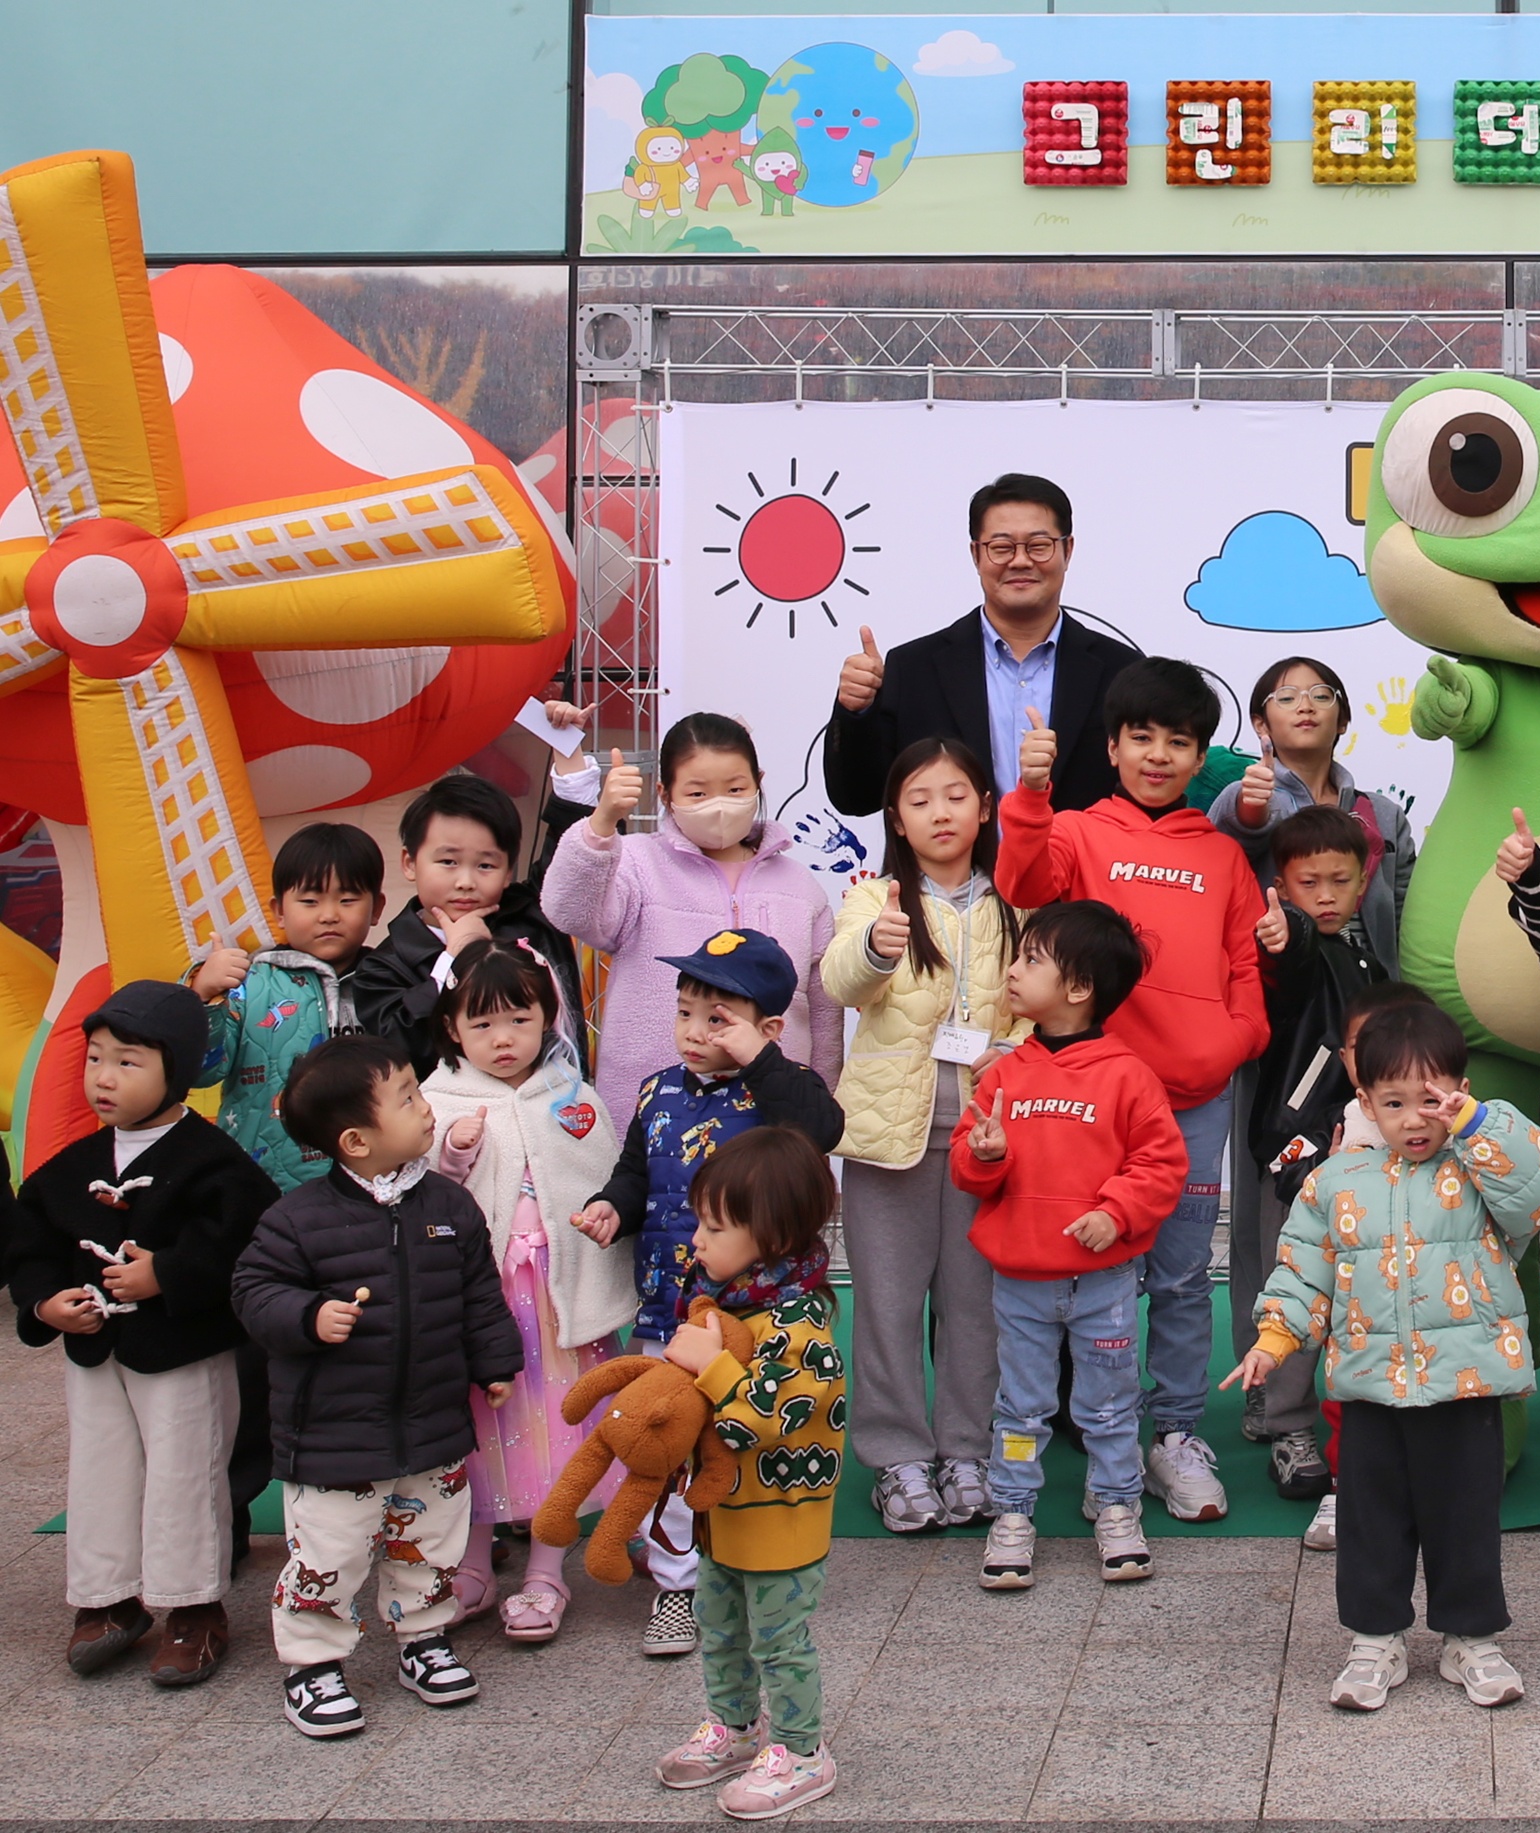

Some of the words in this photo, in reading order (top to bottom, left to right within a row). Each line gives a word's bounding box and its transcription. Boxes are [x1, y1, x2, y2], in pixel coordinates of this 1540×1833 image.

[1109, 861, 1206, 894] MARVEL
[1009, 1098, 1097, 1123] MARVEL
[1188, 1185, 1208, 1194] TURN
[1095, 1340, 1113, 1348] TURN
[1114, 1340, 1121, 1348] IT
[1453, 1650, 1466, 1665] N
